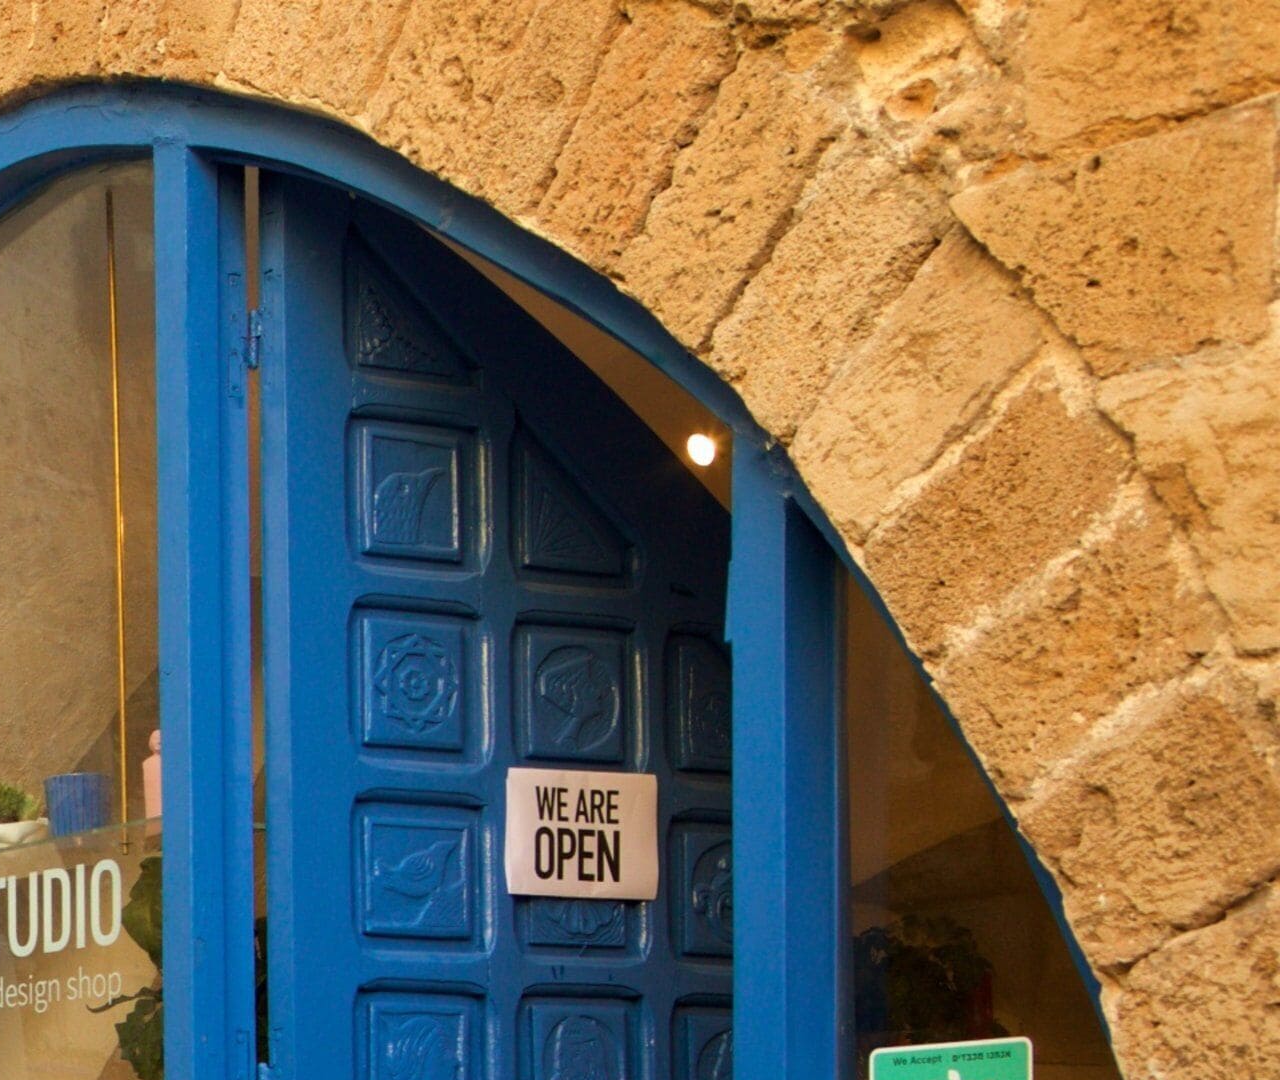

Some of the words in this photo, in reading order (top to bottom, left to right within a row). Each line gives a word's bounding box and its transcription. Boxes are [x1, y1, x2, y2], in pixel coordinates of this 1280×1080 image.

[535, 786, 569, 822] WE
[575, 788, 620, 825] ARE
[534, 826, 620, 883] OPEN
[66, 966, 122, 1005] shop
